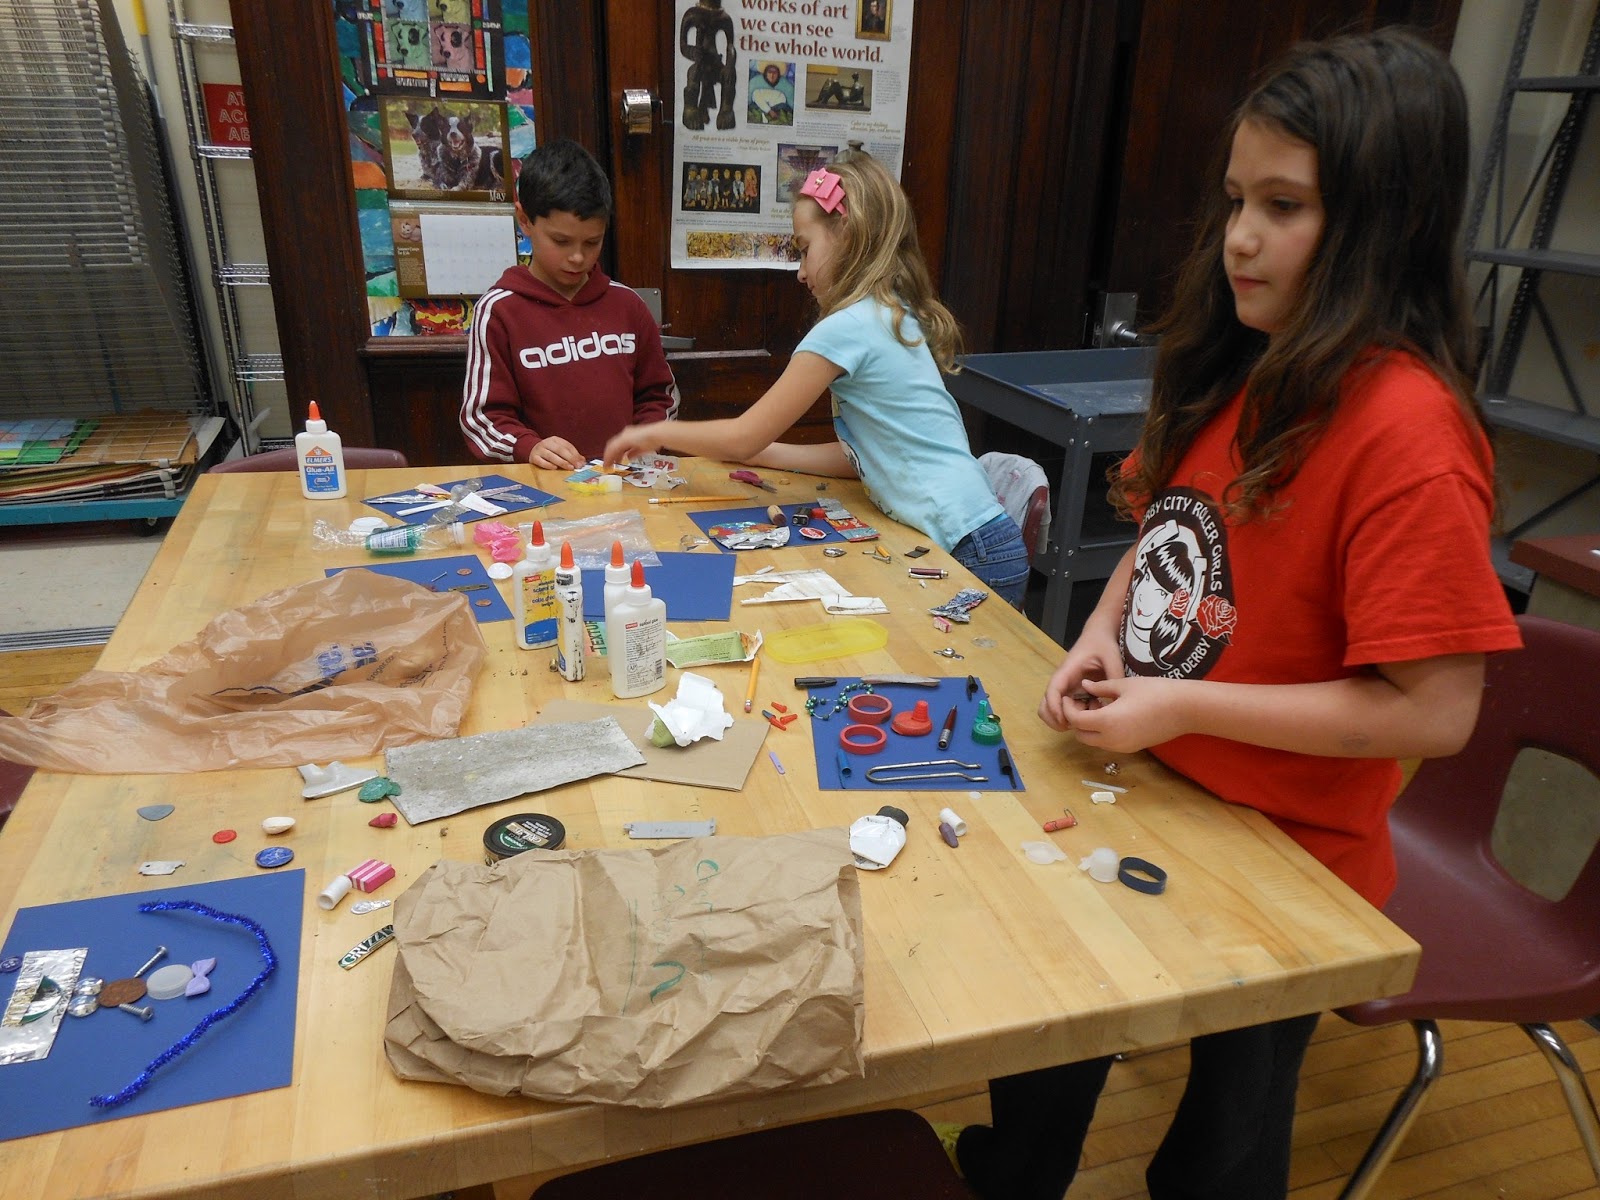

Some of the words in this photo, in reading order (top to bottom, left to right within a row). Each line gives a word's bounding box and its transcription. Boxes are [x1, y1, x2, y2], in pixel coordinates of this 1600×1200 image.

[741, 0, 797, 14] works
[801, 0, 819, 16] of
[822, 4, 848, 19] art
[740, 17, 766, 32] we
[770, 20, 801, 35] can
[806, 23, 834, 38] see
[739, 34, 770, 53] the
[774, 39, 828, 58] whole
[832, 46, 884, 63] world.
[219, 109, 248, 124] AC
[489, 190, 506, 202] May
[519, 331, 636, 369] adidas
[1163, 496, 1193, 513] CITY
[1192, 501, 1219, 545] ROLLER
[1210, 544, 1223, 592] GIRLS
[1181, 637, 1211, 674] DERBY
